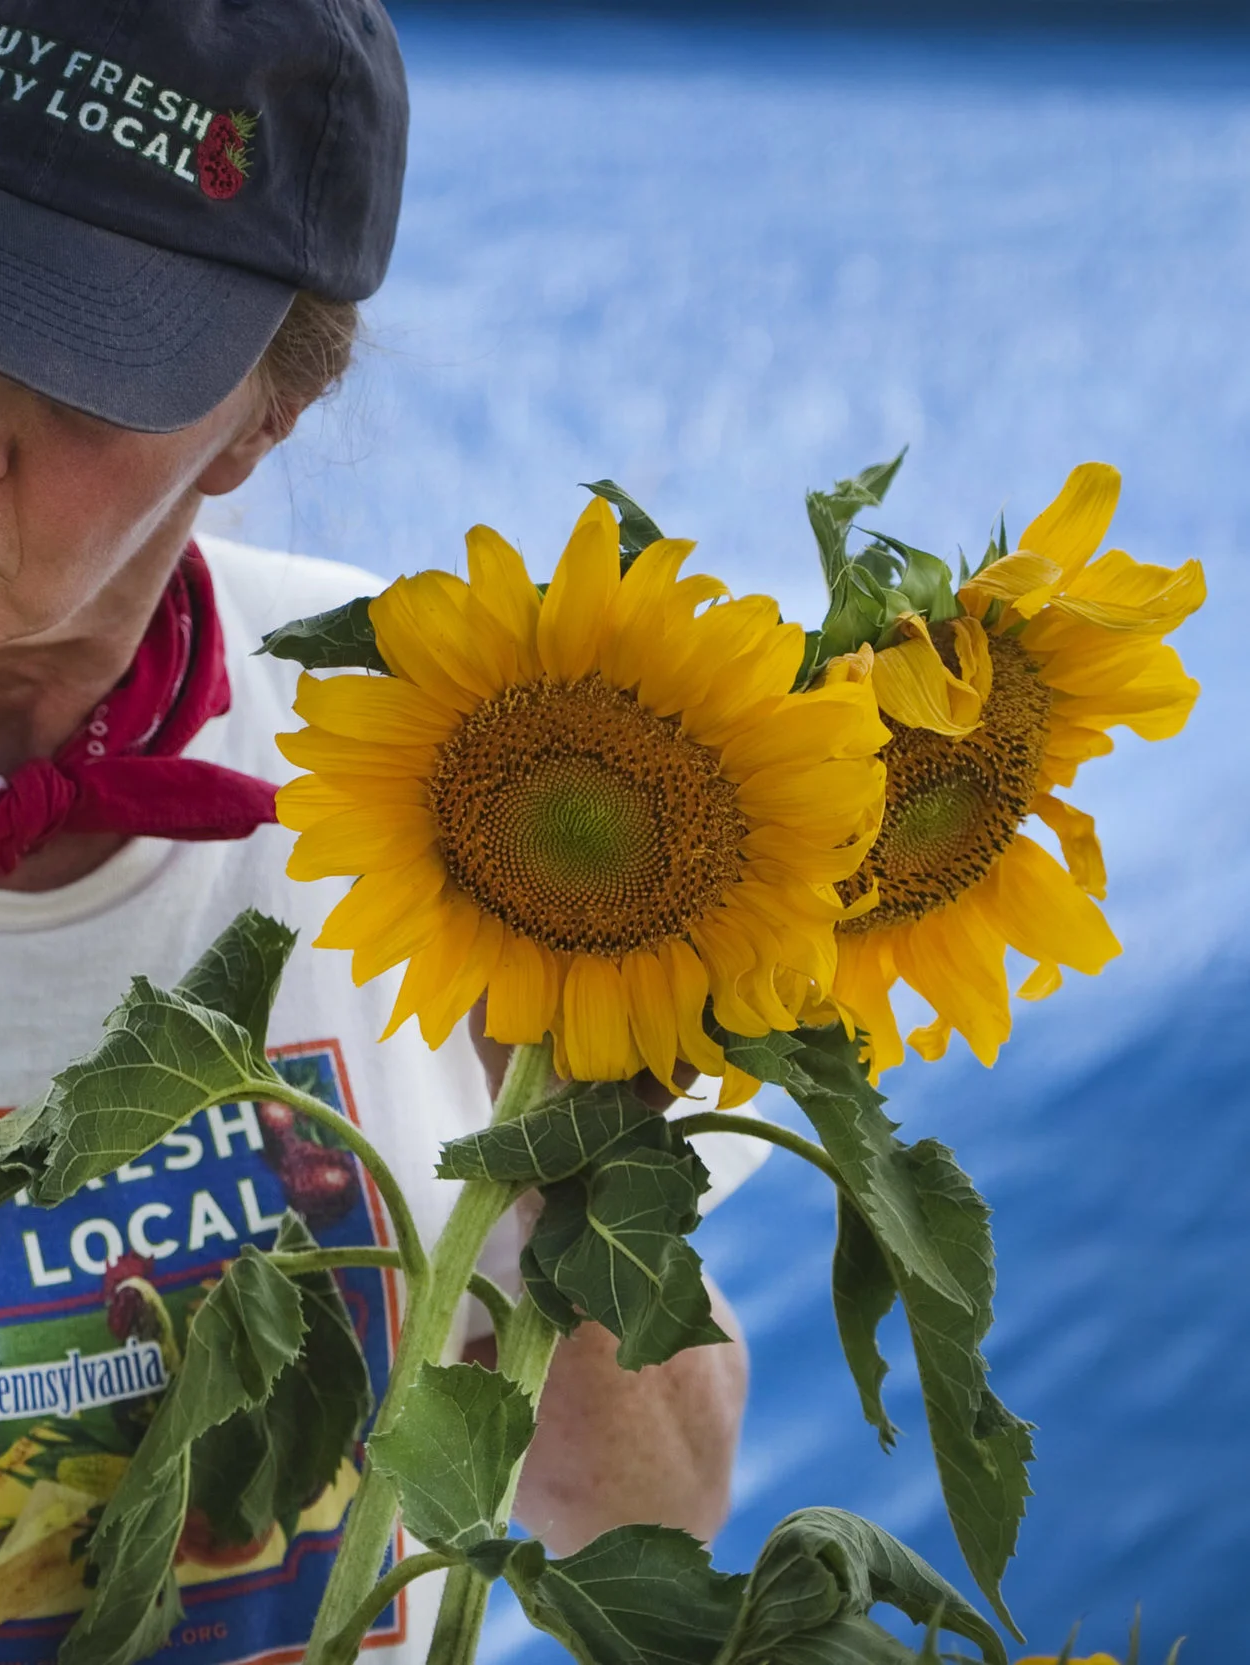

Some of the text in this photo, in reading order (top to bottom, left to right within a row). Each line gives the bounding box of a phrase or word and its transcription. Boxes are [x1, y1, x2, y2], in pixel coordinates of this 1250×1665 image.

[46, 89, 195, 182] LOCAL
[64, 51, 212, 142] FRESH
[22, 1178, 283, 1287] LOCAL
